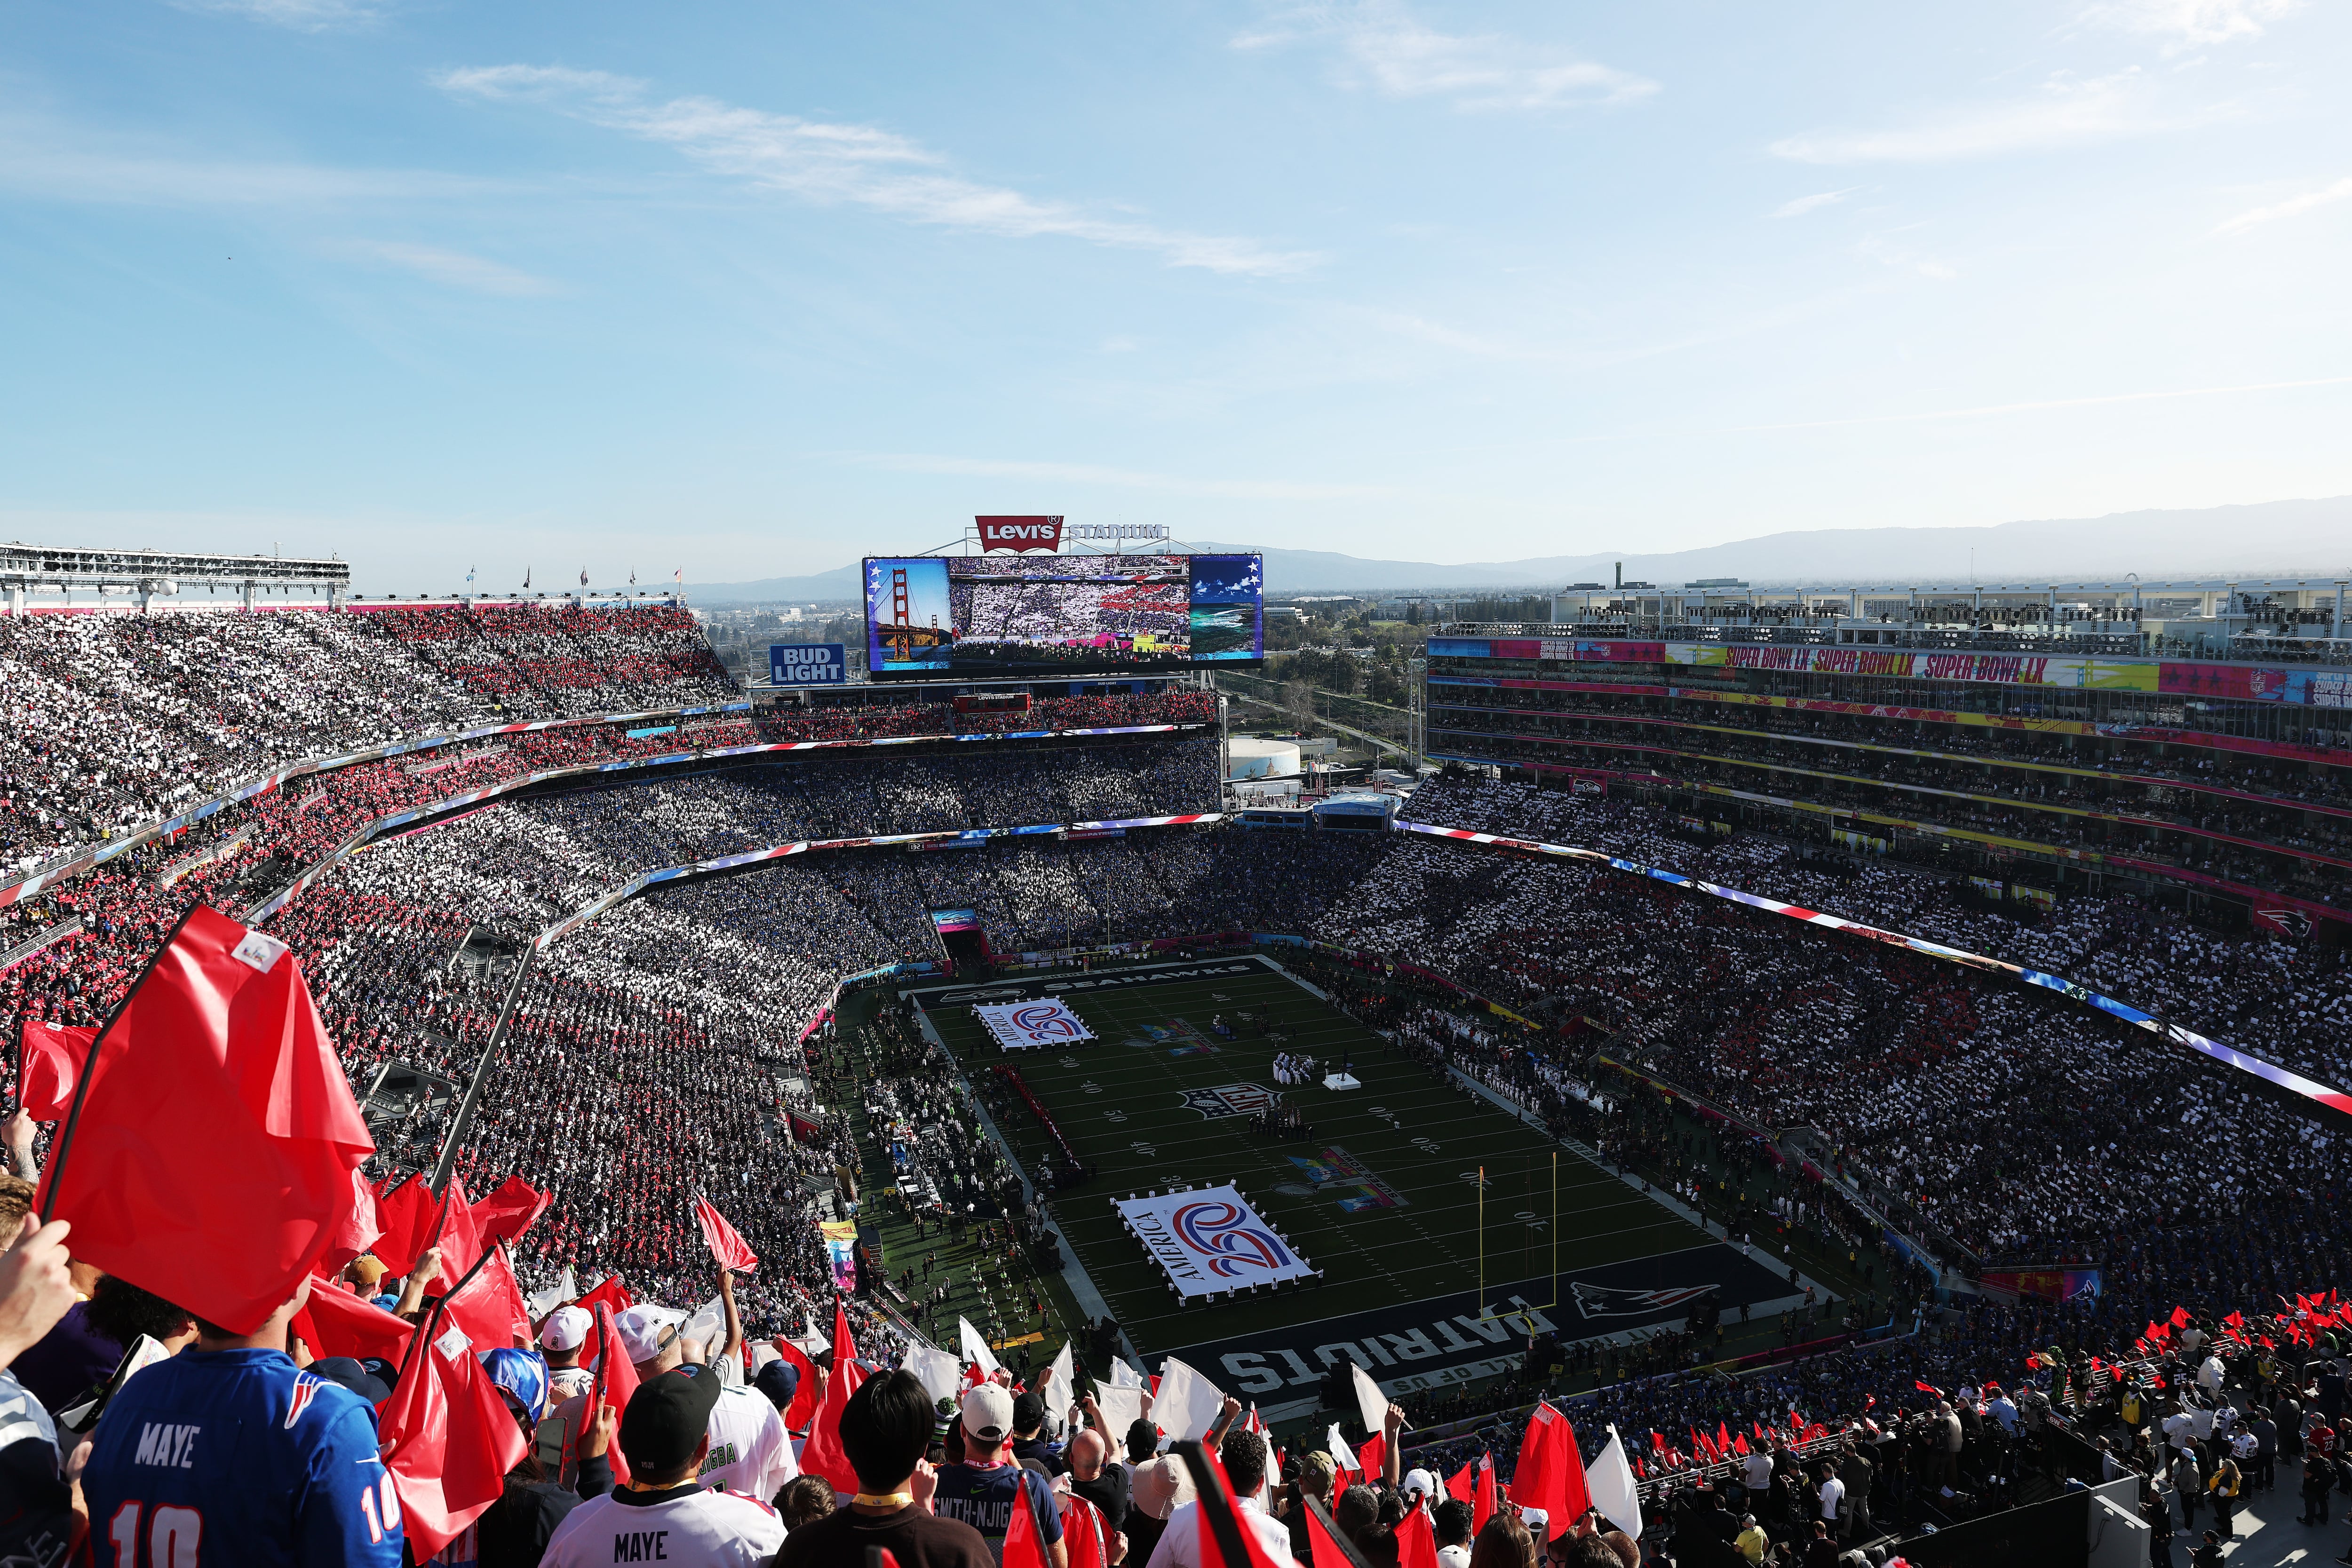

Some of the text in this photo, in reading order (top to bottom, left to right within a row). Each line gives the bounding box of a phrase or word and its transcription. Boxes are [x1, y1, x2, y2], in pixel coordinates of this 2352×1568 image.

[1069, 524, 1163, 539] STADIUM
[783, 648, 831, 665] BUD
[1725, 646, 1811, 670] SUPER BOWL LX
[1815, 649, 1917, 676] SUPER BOWL LX
[1924, 654, 2049, 684] SUPER BOWL LX
[775, 664, 840, 681] LIGHT
[2313, 693, 2343, 707] SUPER
[1040, 949, 1057, 958] SUPER
[1041, 971, 1096, 979] CHOOSE
[1044, 965, 1251, 991] SEAHAWKS
[986, 1012, 1023, 1042] AMERICA
[1180, 1021, 1216, 1048] SUPER BOWL
[1219, 1086, 1273, 1111] NFL
[1104, 1109, 1128, 1122] 50
[1130, 1141, 1156, 1154] 40
[1339, 1151, 1398, 1199] SUPER BOWL
[1132, 1212, 1205, 1281] AMERICA
[1218, 1295, 1560, 1394] PATRIOTS
[1439, 1367, 1473, 1383] OF
[135, 1422, 201, 1468] MAYE
[2324, 1441, 2333, 1451] 23
[696, 1442, 736, 1477] JIGBA
[360, 1471, 400, 1544] 10
[108, 1499, 204, 1568] 10
[614, 1531, 668, 1563] MAYE
